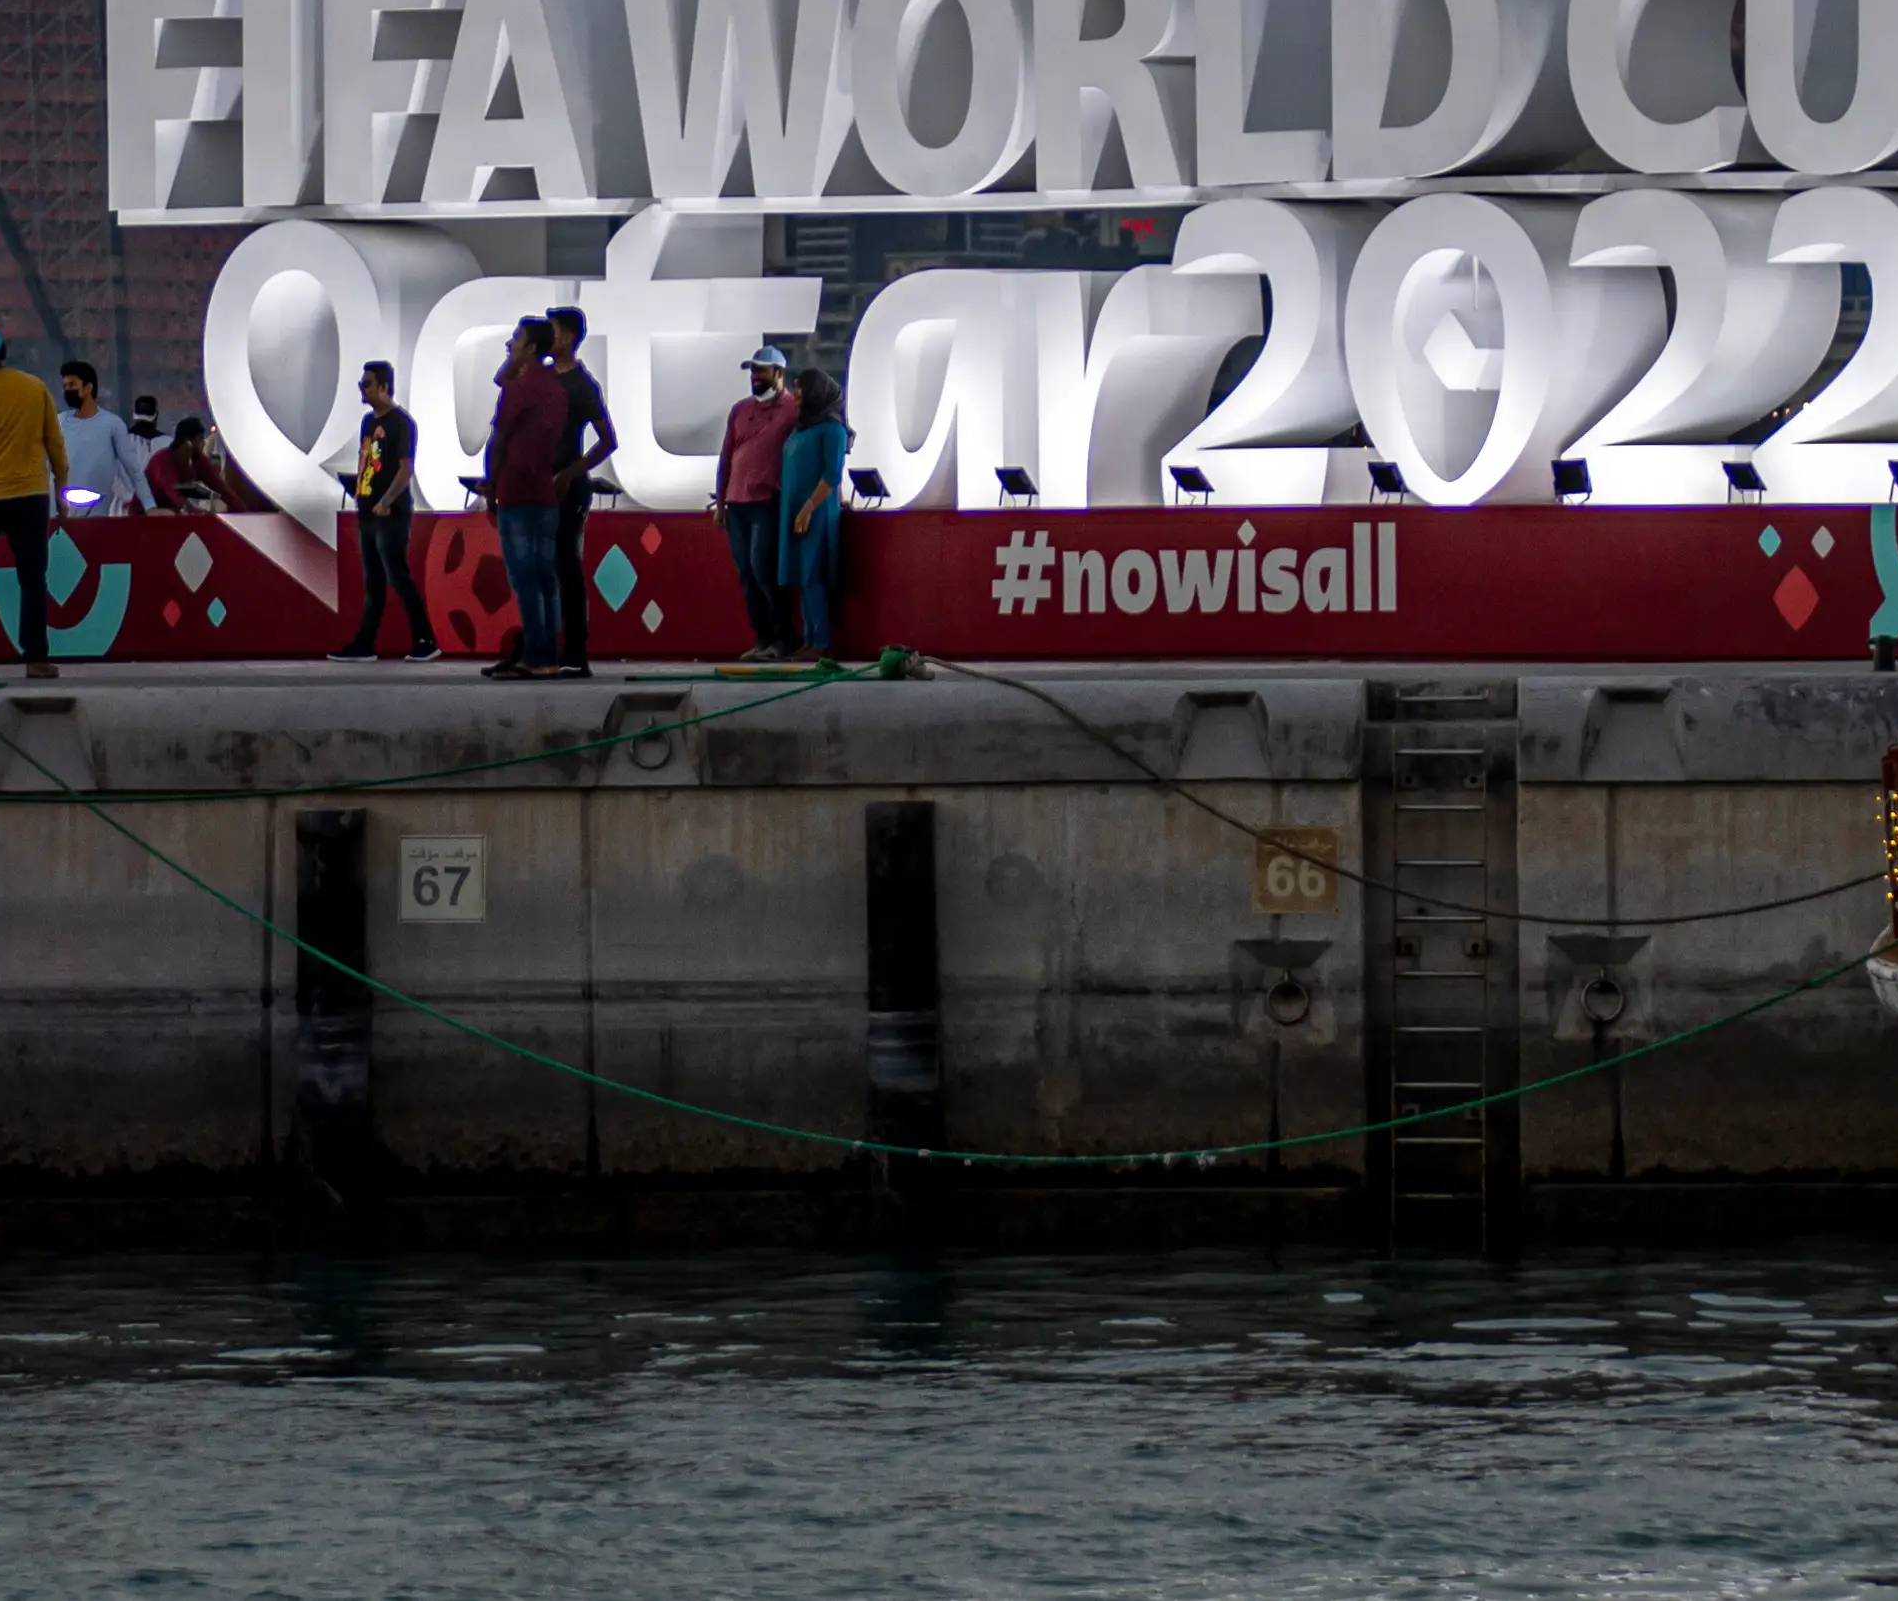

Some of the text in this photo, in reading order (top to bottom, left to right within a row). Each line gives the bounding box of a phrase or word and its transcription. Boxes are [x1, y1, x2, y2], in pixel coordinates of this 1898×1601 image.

[991, 519, 1398, 615] #nowisall
[412, 865, 471, 906] 67
[1266, 855, 1326, 898] 66
